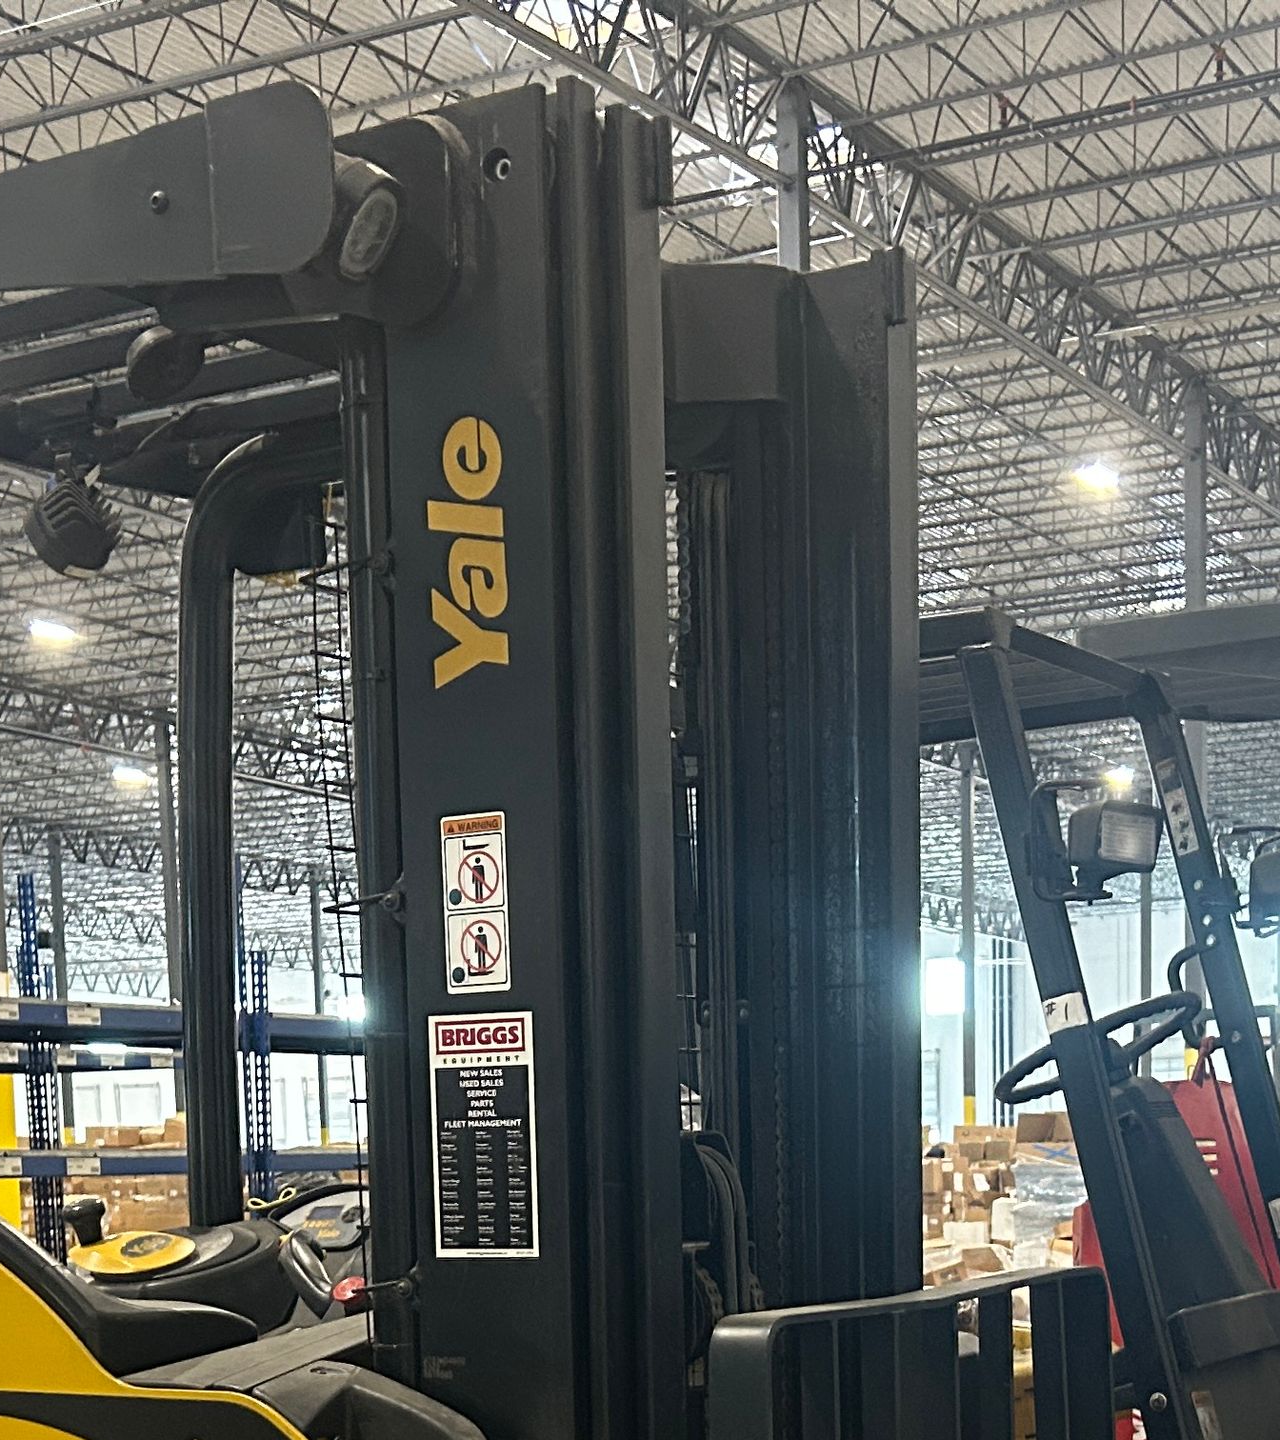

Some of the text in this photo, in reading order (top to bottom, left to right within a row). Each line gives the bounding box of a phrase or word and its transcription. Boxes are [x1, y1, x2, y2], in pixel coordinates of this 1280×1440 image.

[426, 415, 510, 690] Yale
[458, 818, 499, 832] WARNING
[441, 1025, 520, 1047] BRIGGS
[459, 1068, 503, 1078] NEW SALES
[459, 1078, 504, 1088] USED SALES
[466, 1088, 497, 1098] SERVICE
[470, 1099, 494, 1108] PARTS
[467, 1108, 497, 1118] RENTAL
[444, 1118, 522, 1129] FLEET MANAGEMENT
